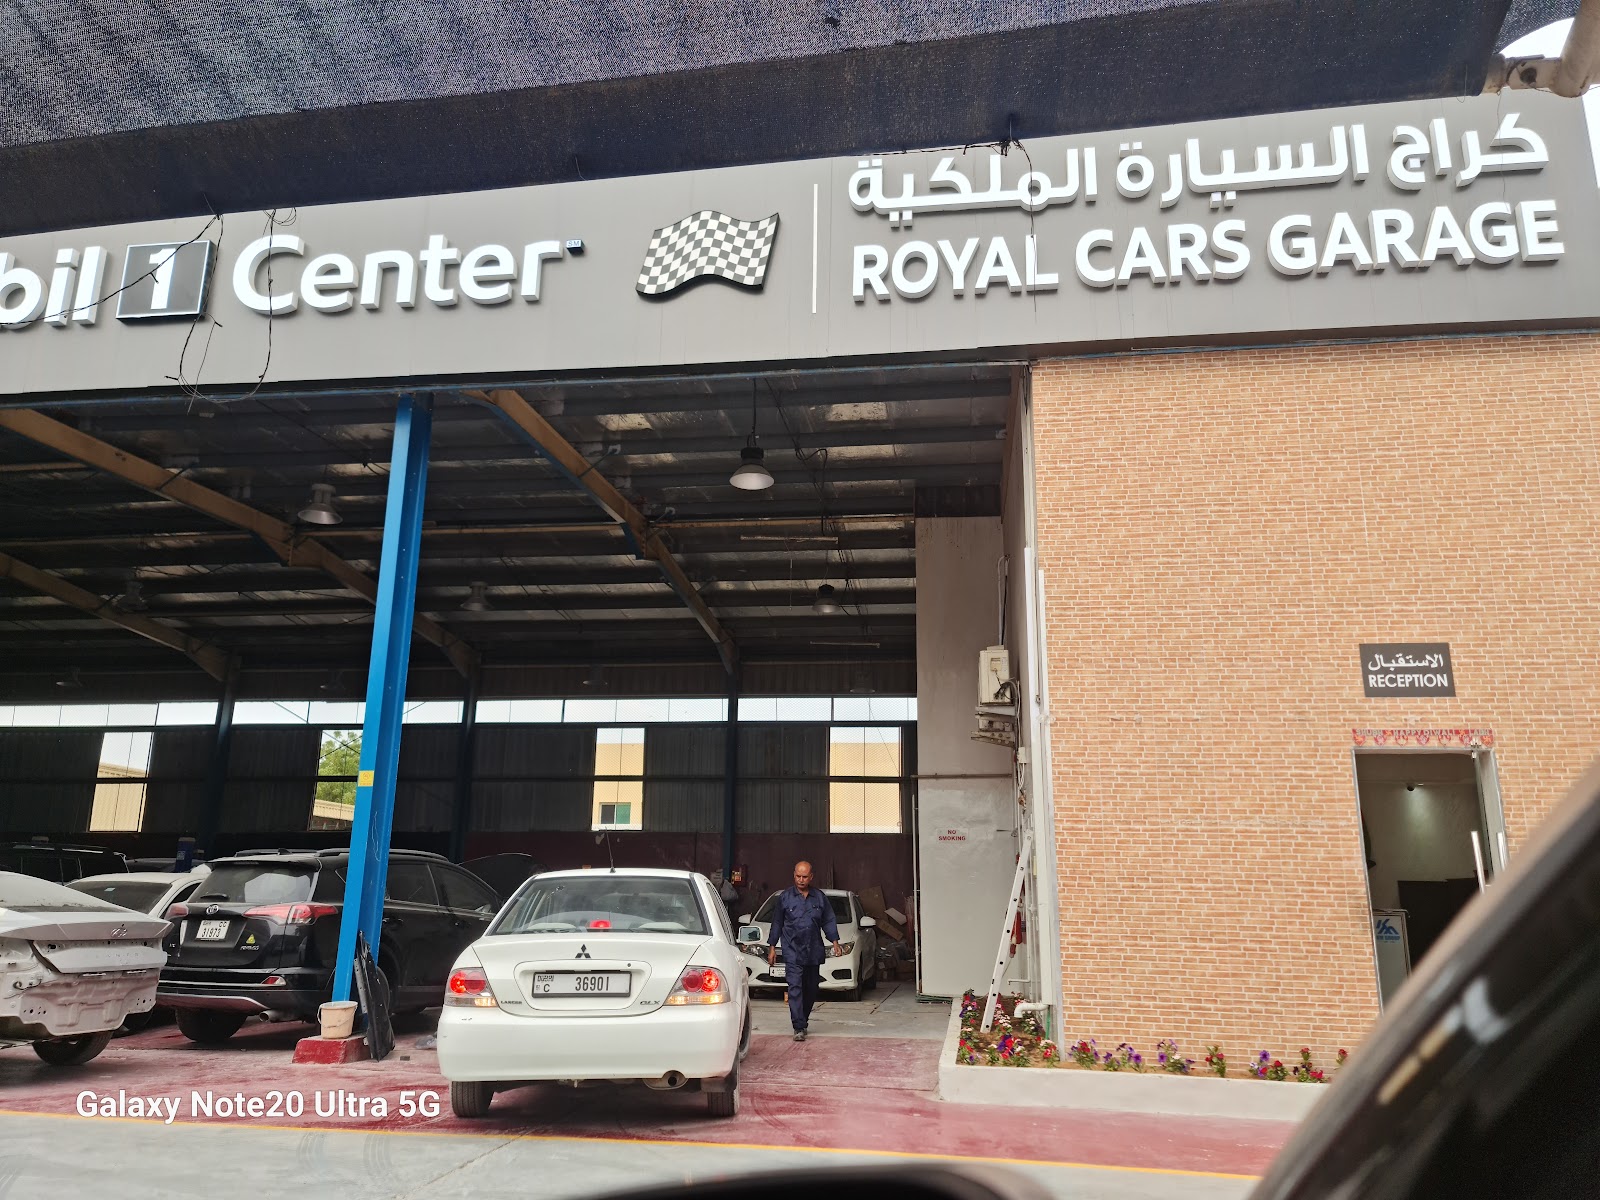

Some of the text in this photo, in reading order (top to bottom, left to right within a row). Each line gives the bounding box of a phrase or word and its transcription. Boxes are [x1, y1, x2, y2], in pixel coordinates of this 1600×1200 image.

[848, 112, 1549, 228] كراج السيارة الملكية
[232, 233, 563, 316] Center
[852, 199, 1566, 302] ROYAL CARS GARAGE
[1368, 653, 1444, 671] الاستقبال
[1368, 674, 1449, 688] RECEPTION
[543, 976, 610, 993] C 36901
